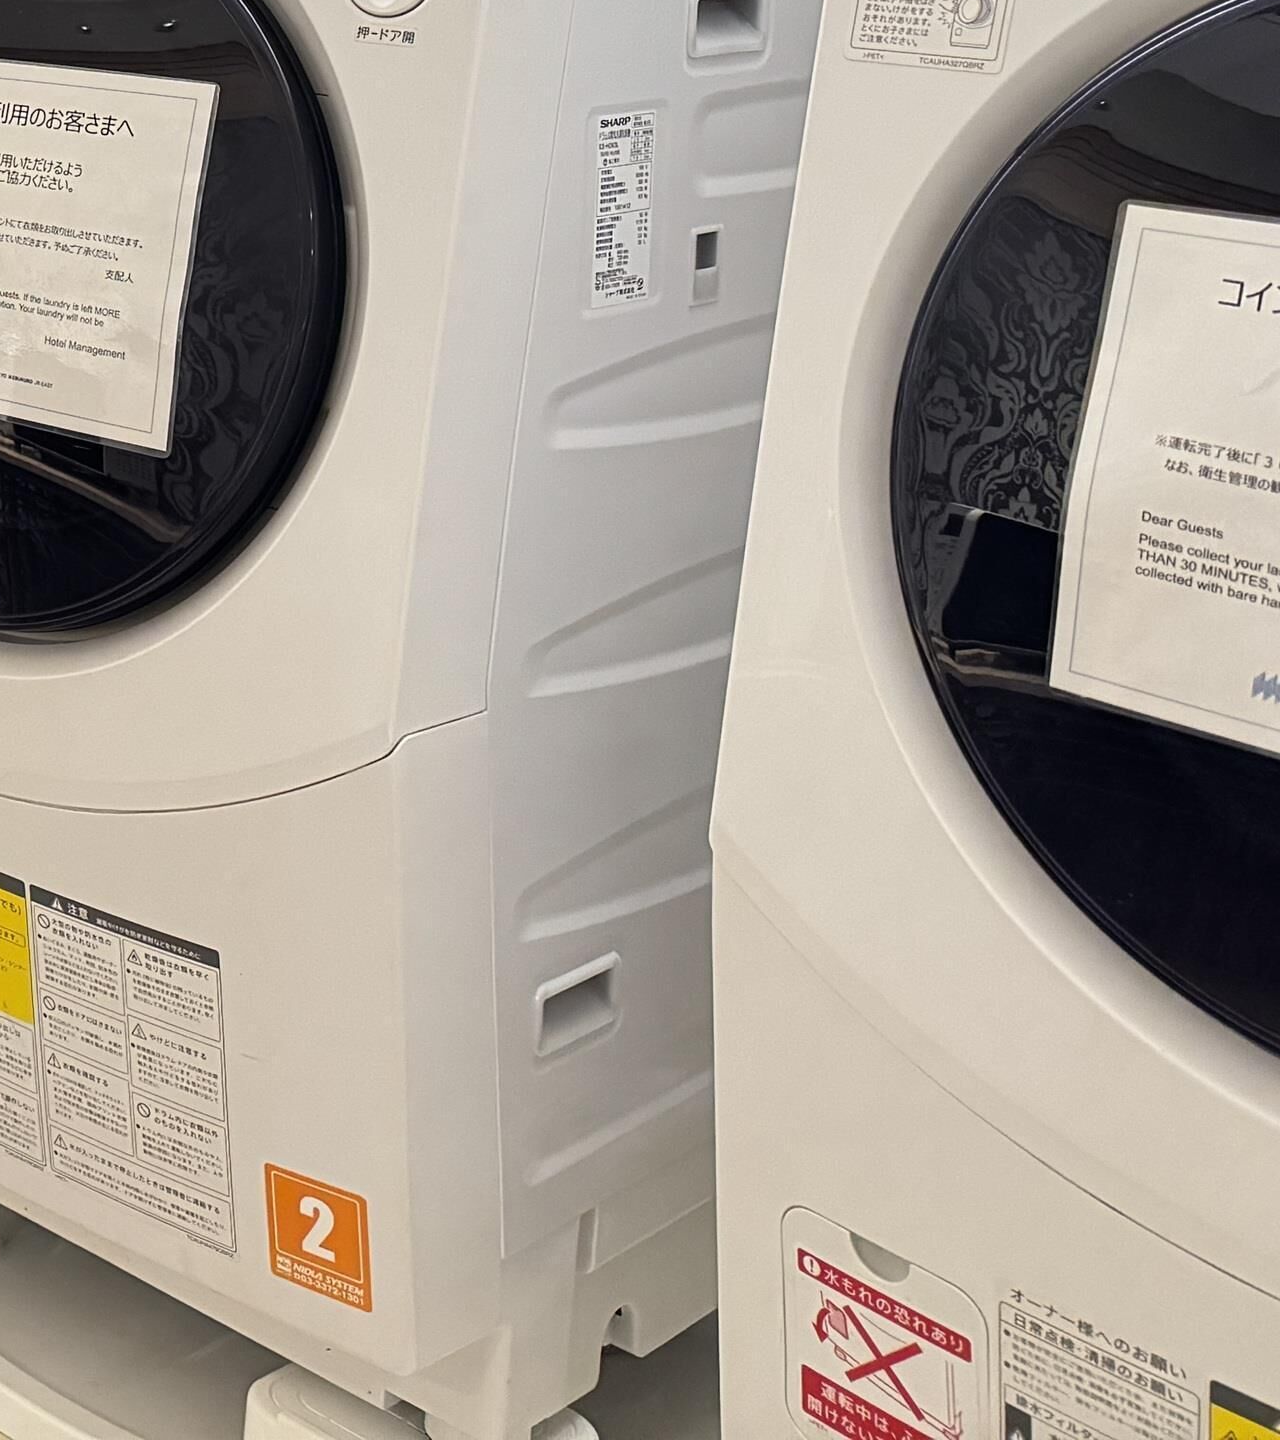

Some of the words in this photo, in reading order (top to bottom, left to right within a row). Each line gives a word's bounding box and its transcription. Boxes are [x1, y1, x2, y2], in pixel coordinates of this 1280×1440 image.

[861, 25, 929, 37] とくにお子さまには
[862, 14, 932, 27] おそれがあります。
[859, 34, 919, 47] ご注意ください。
[600, 116, 631, 128] SHARP
[104, 269, 135, 284] 支配人
[30, 295, 41, 303] the
[43, 297, 71, 310] laundry
[81, 304, 93, 313] left
[94, 307, 121, 319] MORE
[44, 336, 66, 348] Hotel
[68, 340, 126, 360] Management
[1141, 511, 1173, 525] Dear
[1177, 519, 1224, 539] Guests
[1139, 533, 1183, 553] Please
[1187, 547, 1230, 565] collect
[1234, 557, 1264, 572] your
[1138, 548, 1177, 568] THAN
[1180, 558, 1197, 572] 30
[1201, 564, 1272, 593] MINUTES,
[1135, 566, 1193, 587] collected
[1197, 581, 1223, 594] with
[1227, 586, 1257, 603] bare
[67, 903, 89, 920] 注意
[299, 1196, 336, 1263] 2
[823, 1269, 966, 1354] 水もれの恐れあり
[1011, 1288, 1187, 1379] オーナー様へのお願い
